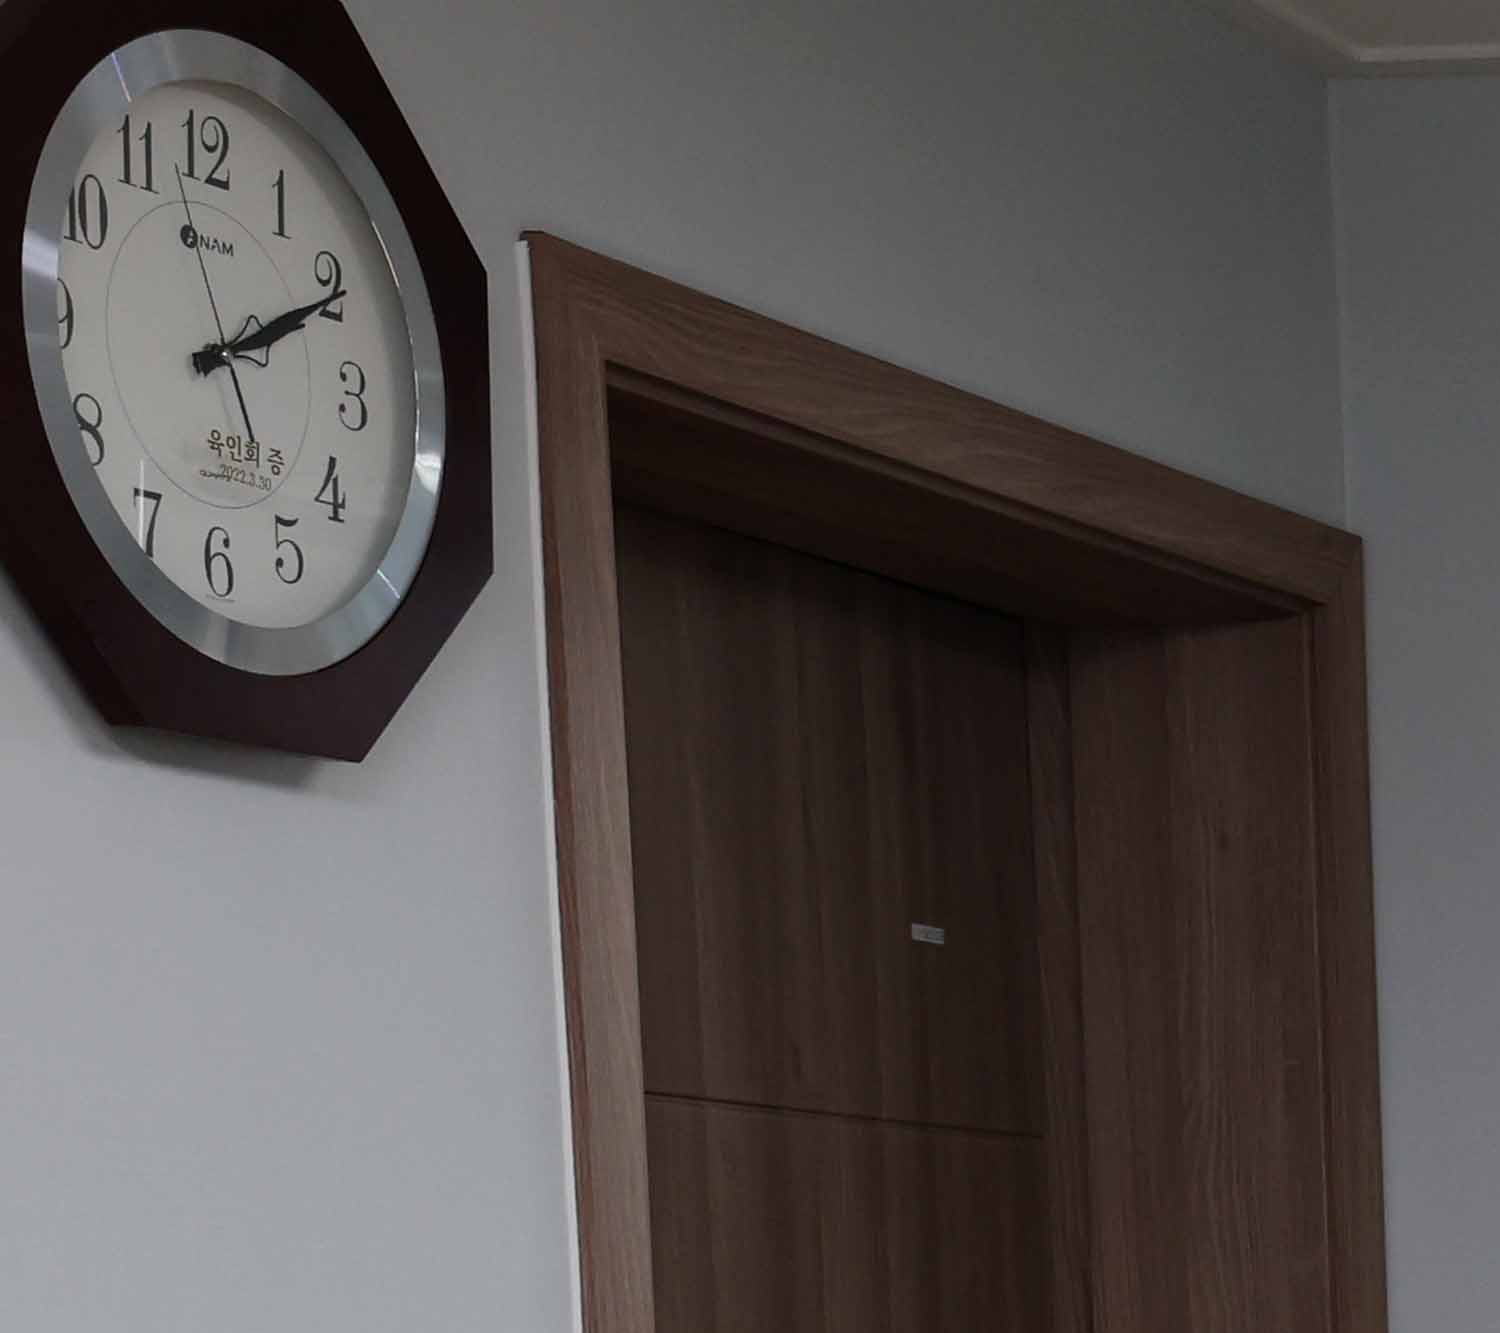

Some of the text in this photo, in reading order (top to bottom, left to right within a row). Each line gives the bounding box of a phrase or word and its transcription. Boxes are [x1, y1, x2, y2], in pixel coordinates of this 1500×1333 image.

[117, 114, 160, 194] 11
[181, 109, 231, 190] 12
[64, 174, 108, 250] 10
[272, 169, 292, 239] 1
[314, 251, 344, 323] 2
[72, 393, 104, 467] 8
[339, 361, 368, 431] 3
[133, 489, 162, 558] 7
[314, 456, 345, 522] 4
[204, 528, 234, 598] 6
[275, 516, 304, 584] 5
